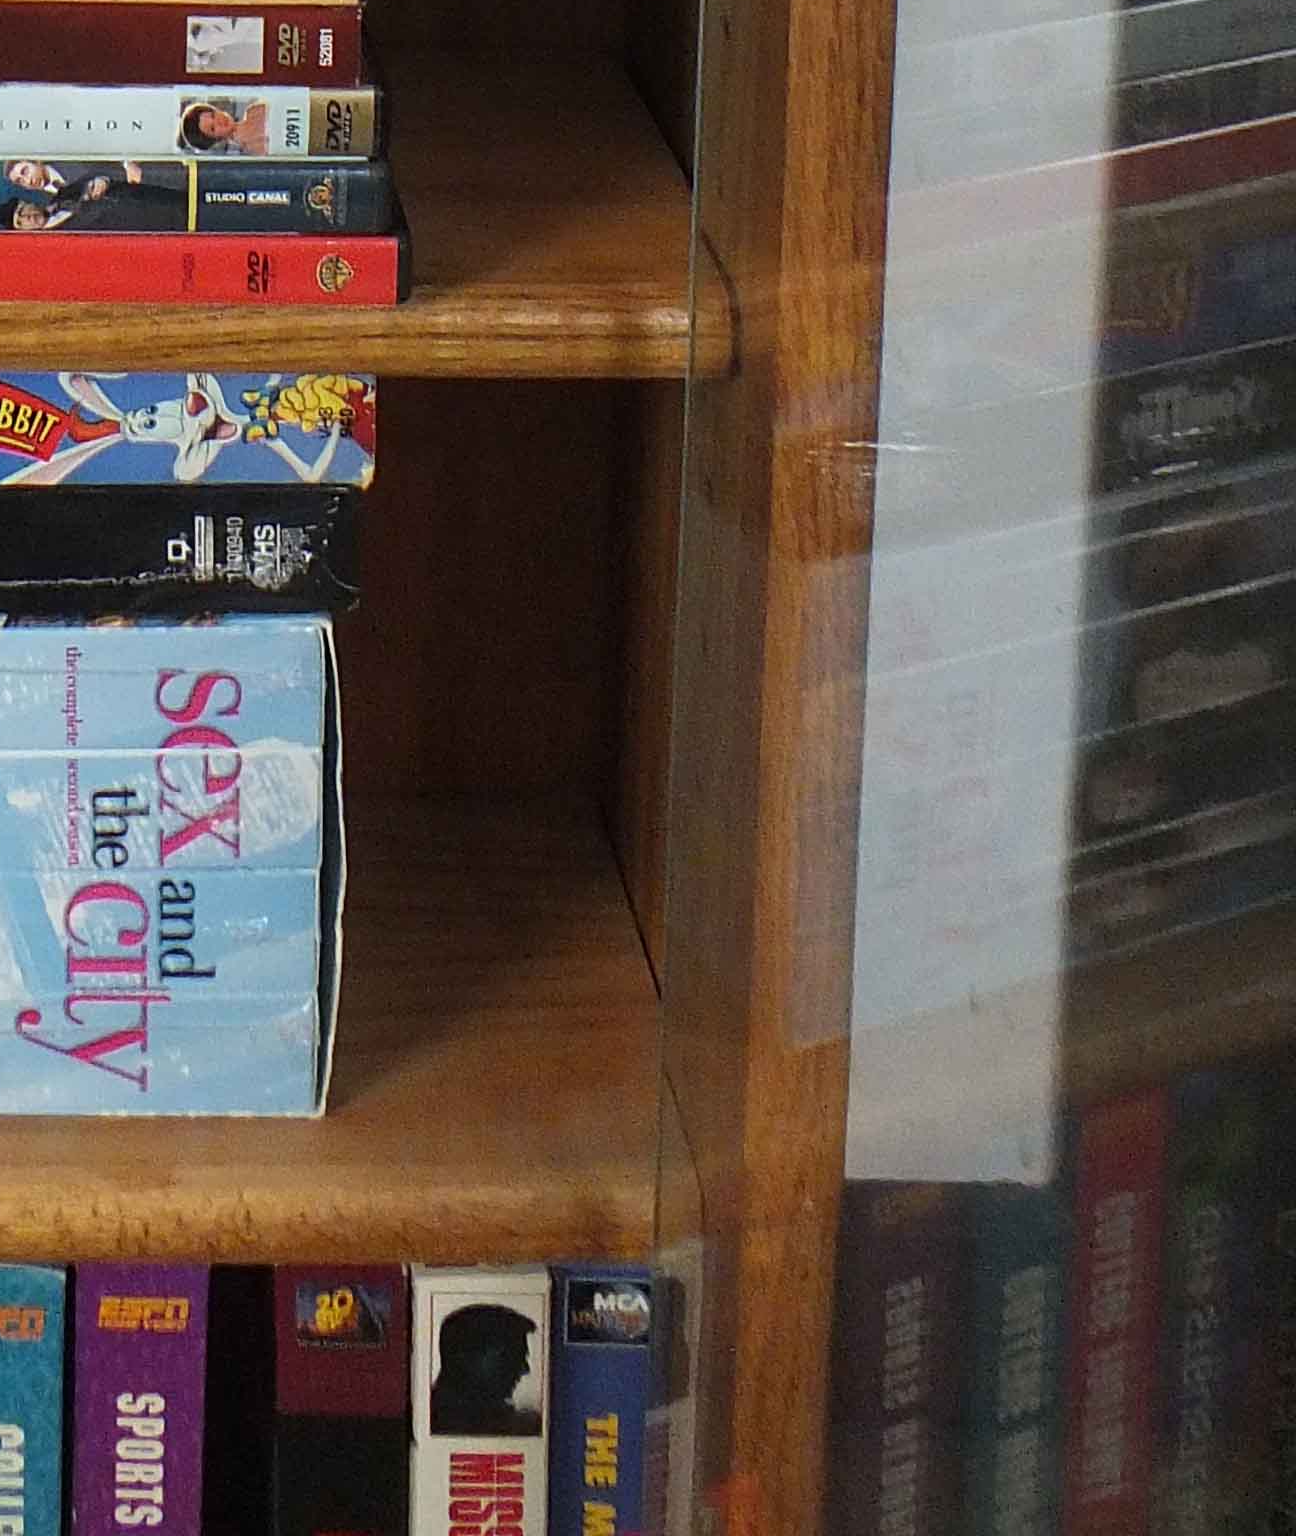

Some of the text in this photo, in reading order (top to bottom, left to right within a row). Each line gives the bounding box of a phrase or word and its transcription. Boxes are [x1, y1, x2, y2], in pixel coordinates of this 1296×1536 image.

[278, 23, 292, 66] DVD
[286, 109, 300, 147] 20911
[326, 99, 342, 152] DVD
[205, 192, 290, 203] STUDIO CANAL
[247, 251, 260, 294] DVD
[254, 525, 275, 577] VHS
[92, 786, 150, 869] the
[158, 879, 216, 980] and
[114, 1391, 165, 1527] SPORTS
[584, 1413, 619, 1487] THE
